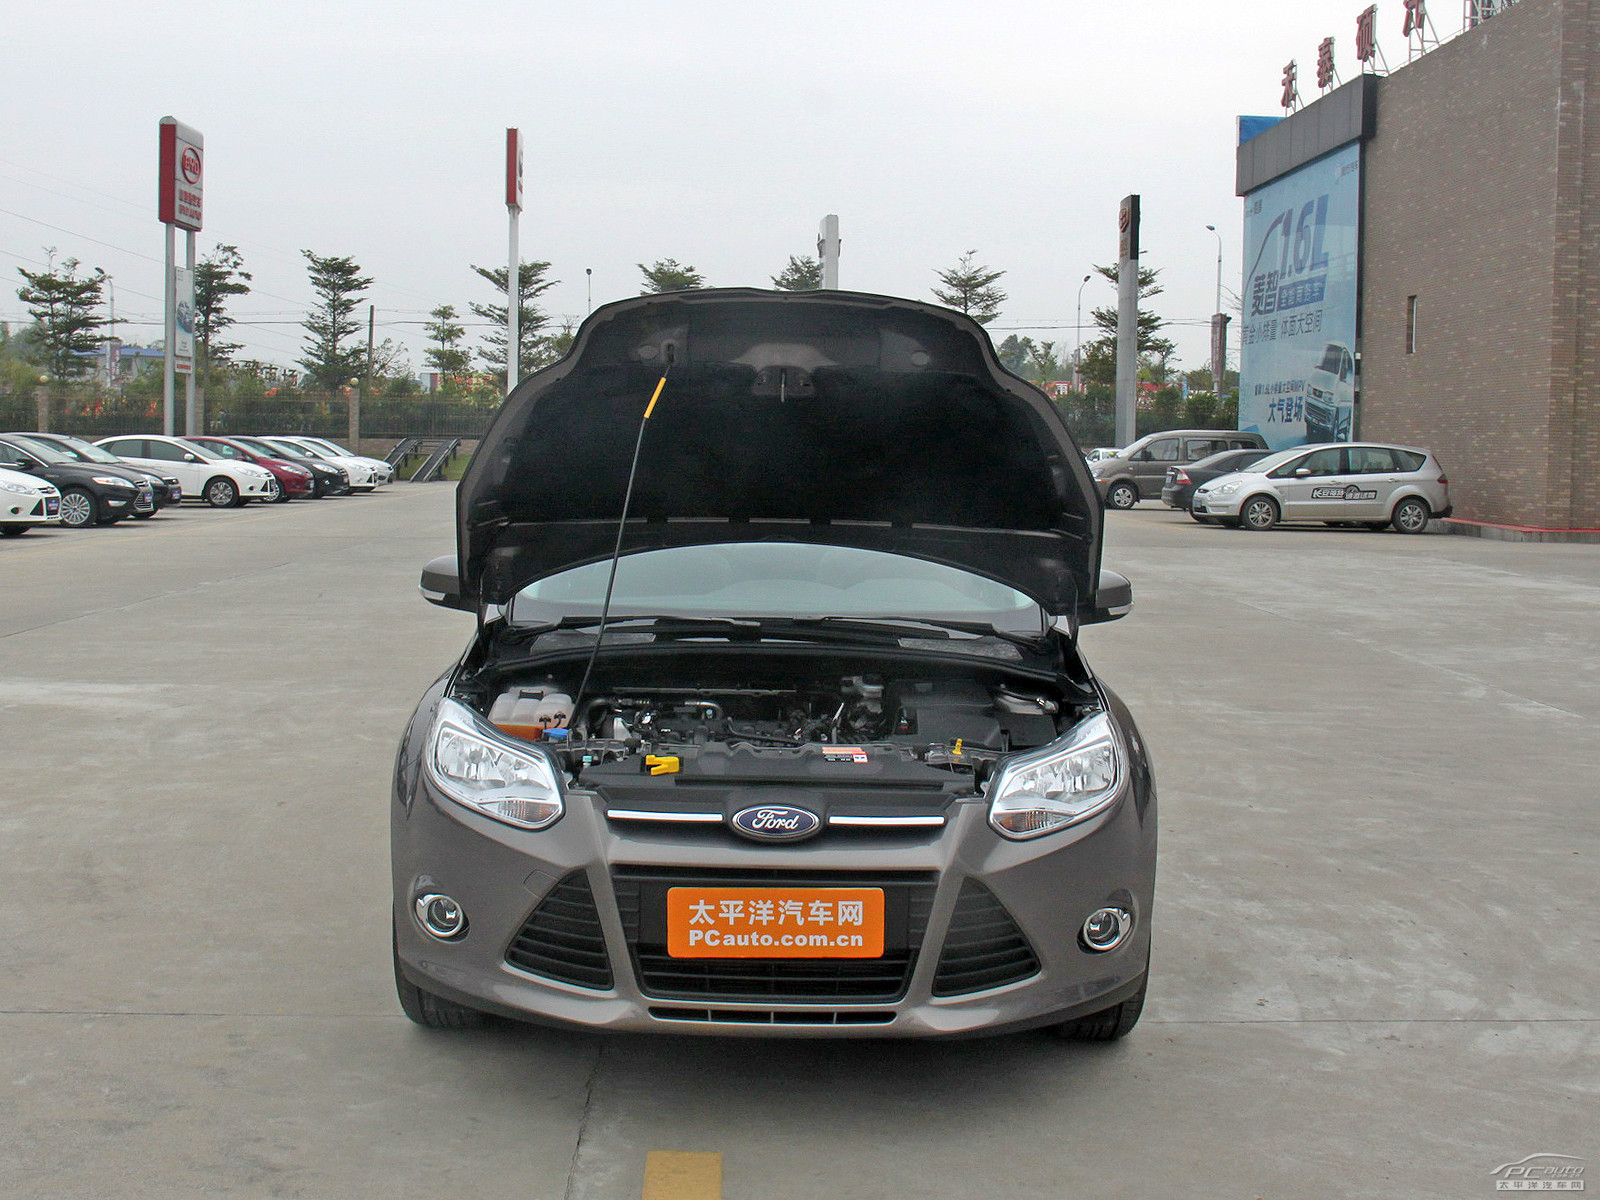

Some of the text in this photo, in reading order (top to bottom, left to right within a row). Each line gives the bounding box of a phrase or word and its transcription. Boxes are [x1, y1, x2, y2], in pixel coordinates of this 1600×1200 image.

[1279, 194, 1329, 280] 1.6L
[751, 808, 800, 831] Ford
[687, 899, 864, 926] 太平洋汽车网
[688, 929, 864, 947] PCauto.com.cn
